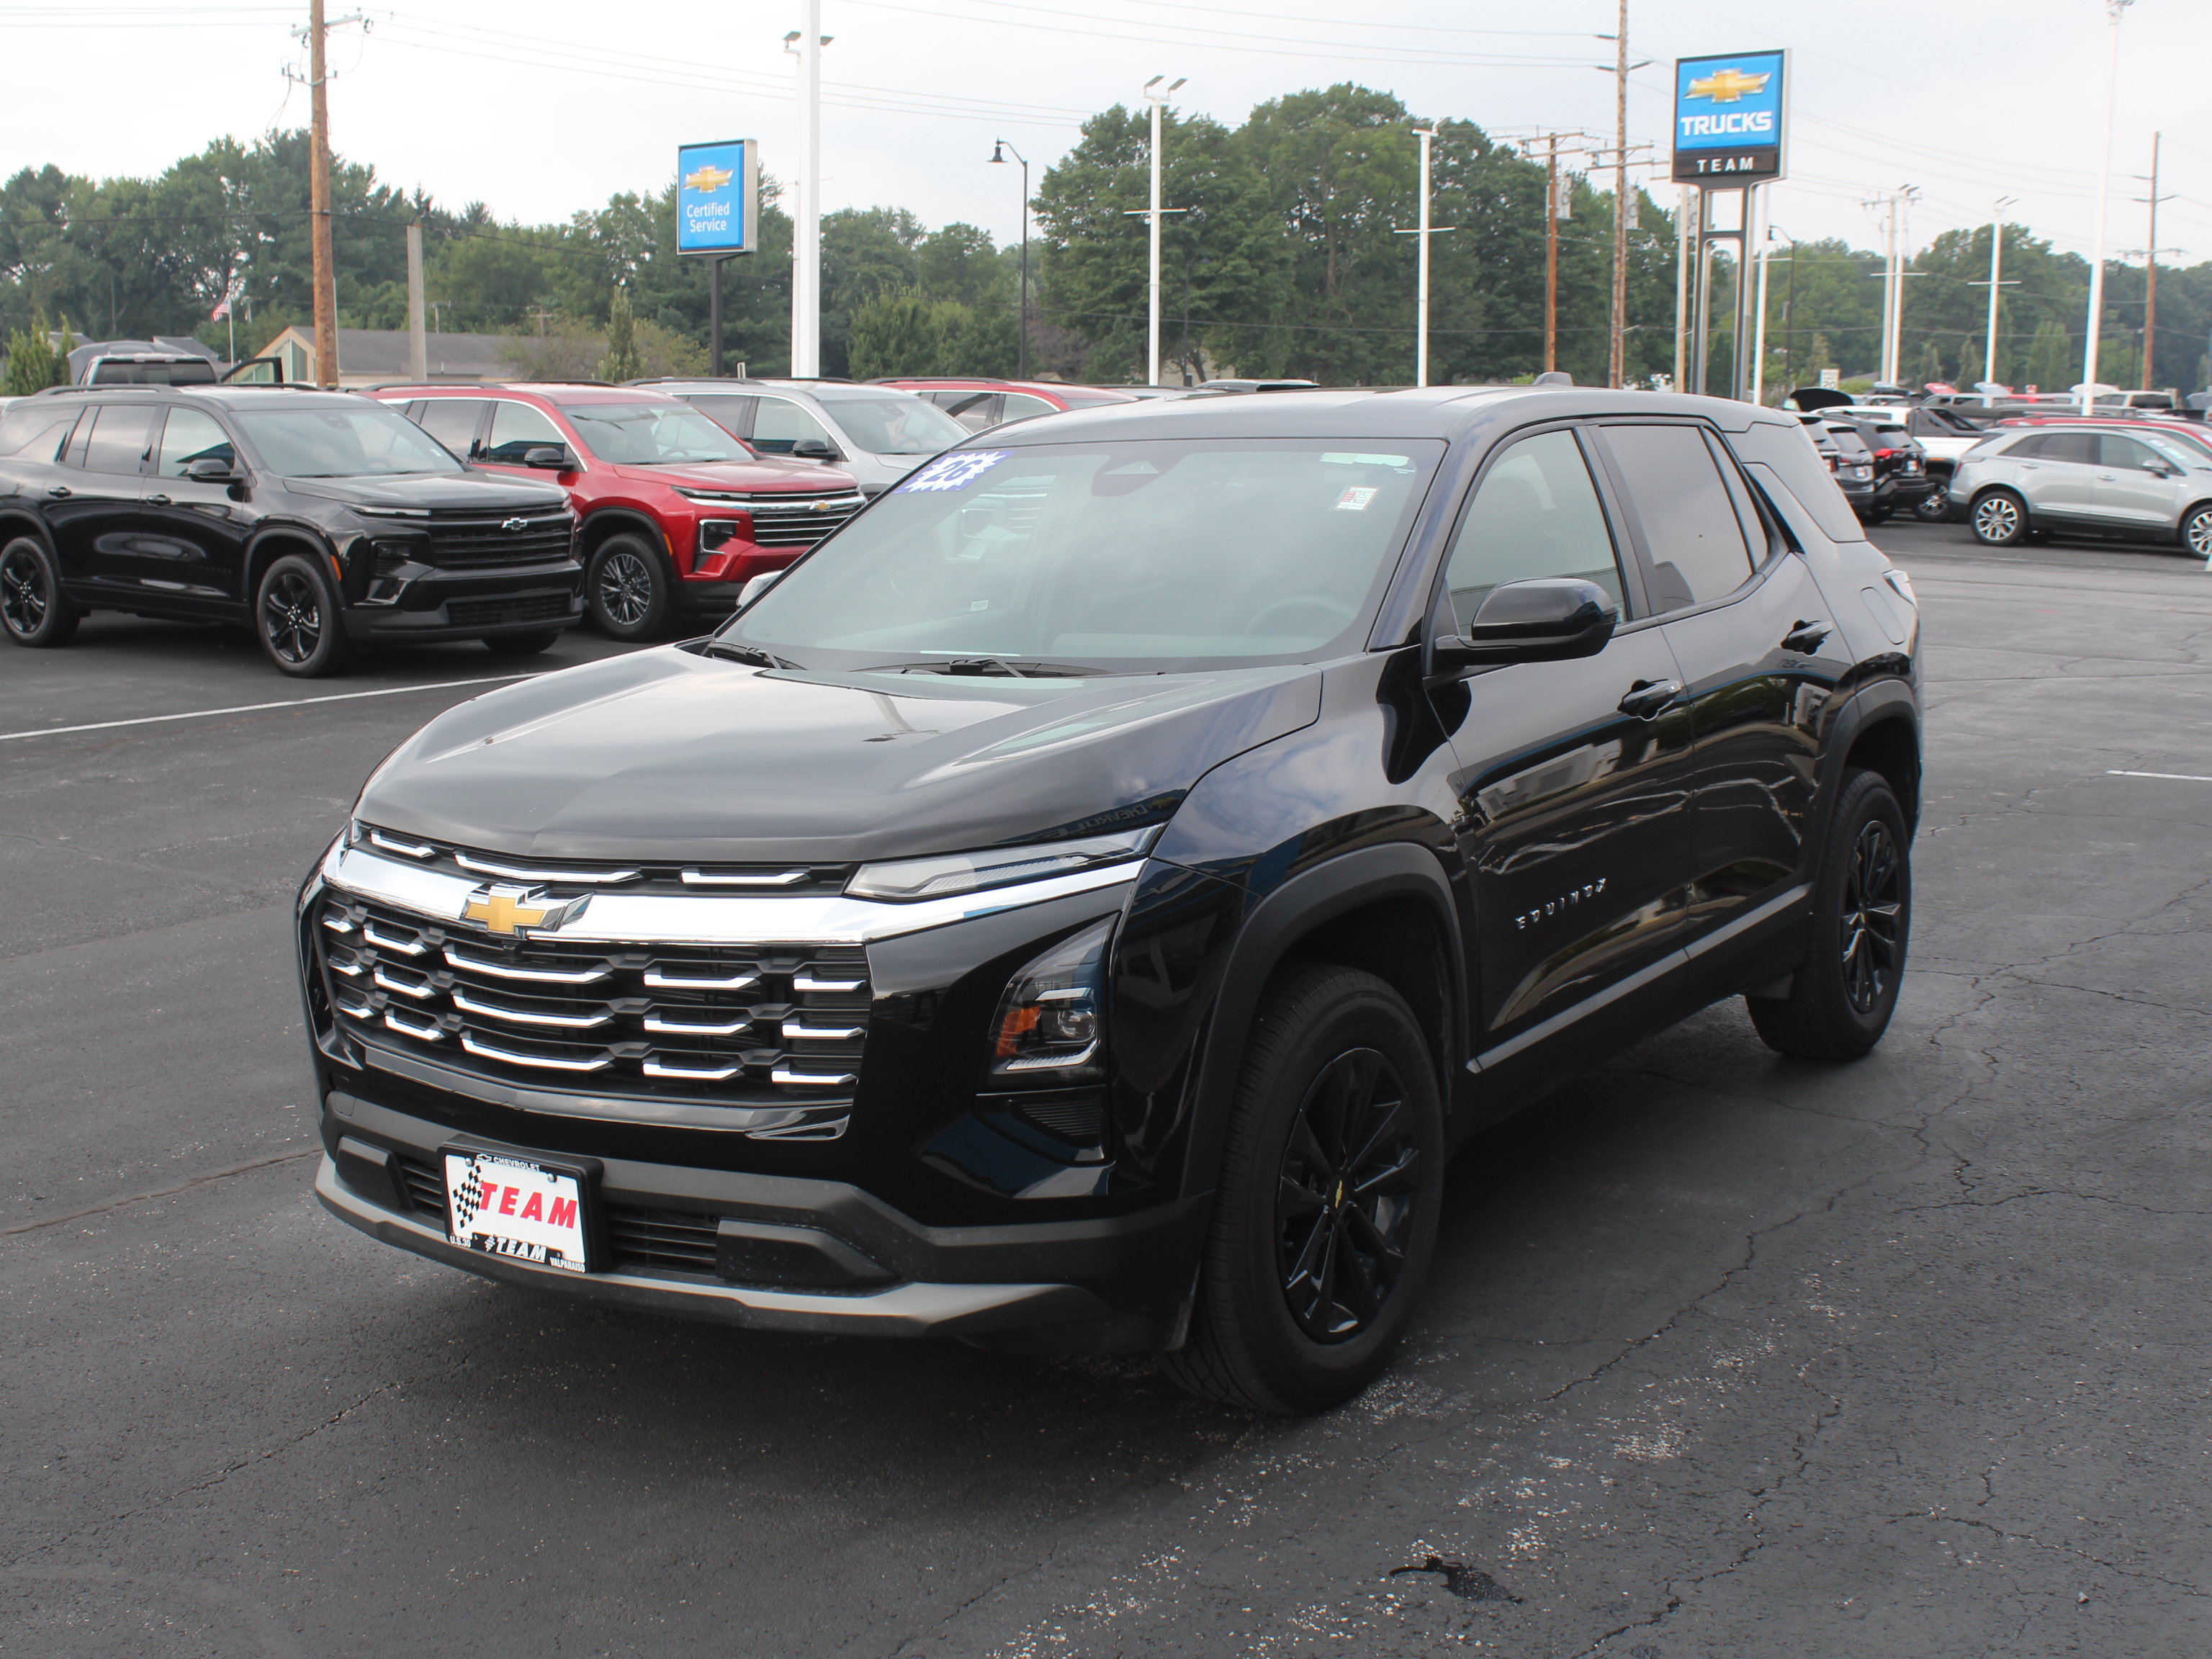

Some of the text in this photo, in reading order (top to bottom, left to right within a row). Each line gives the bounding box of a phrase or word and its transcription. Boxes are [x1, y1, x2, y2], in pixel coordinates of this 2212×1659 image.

[1681, 111, 1773, 136] TRUCKS
[1696, 156, 1754, 173] TEAM
[686, 202, 730, 217] Certified
[690, 218, 727, 233] Service
[1515, 878, 1606, 930] EQUINOX
[493, 1156, 540, 1172] CHEVROLET
[479, 1181, 577, 1229] TEAM
[496, 1236, 548, 1261] TEAM
[549, 1256, 585, 1273] VALPARAISO
